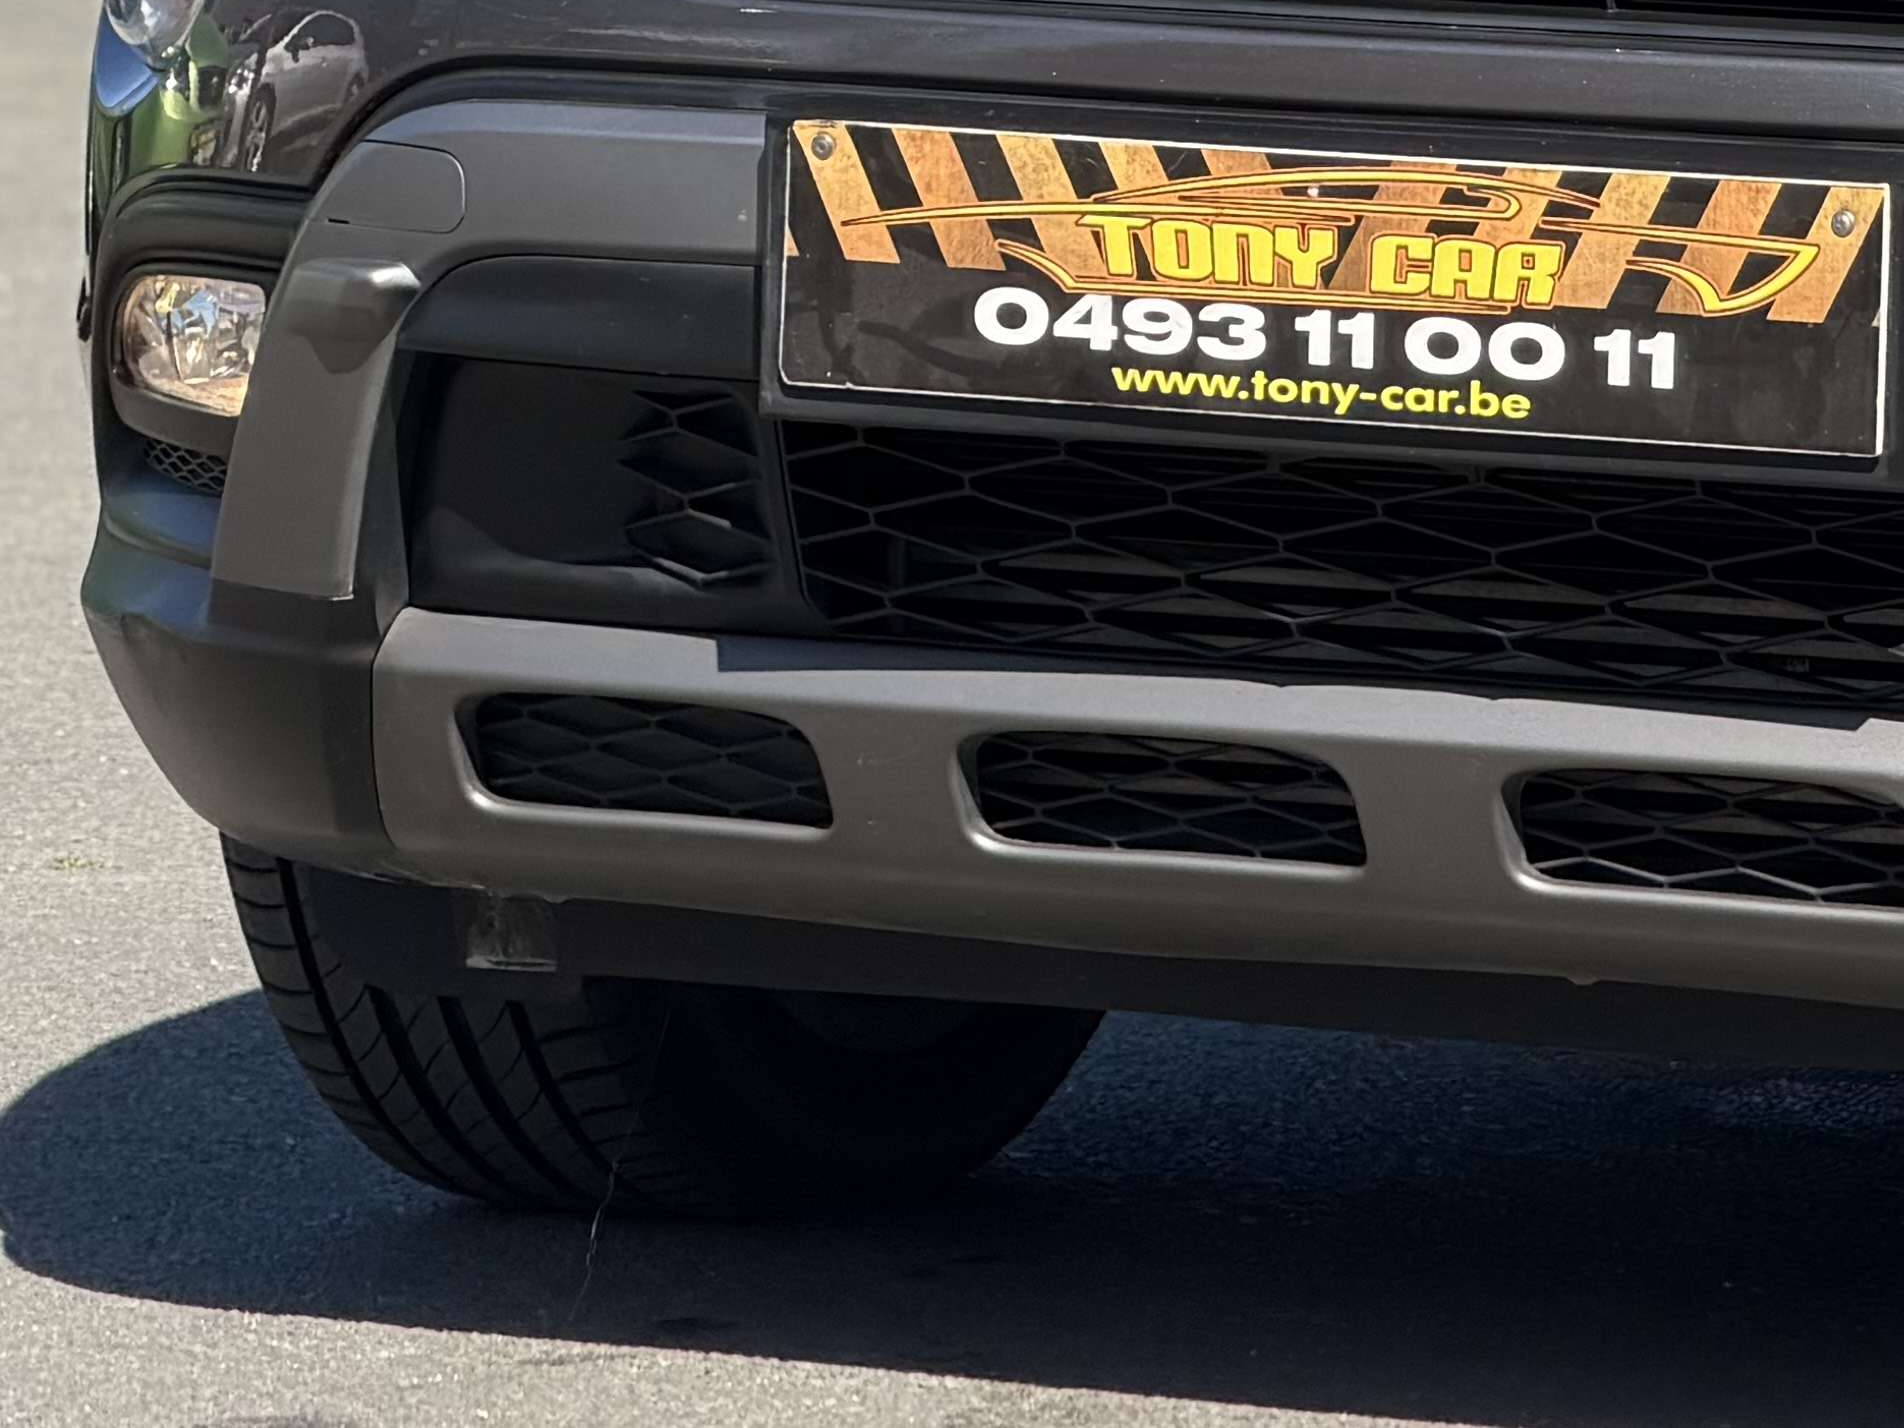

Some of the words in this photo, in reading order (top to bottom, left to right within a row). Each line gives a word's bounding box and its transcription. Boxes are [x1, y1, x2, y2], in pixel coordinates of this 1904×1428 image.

[1075, 213, 1337, 290] TONY
[1367, 233, 1565, 307] CAR
[973, 286, 1267, 361] 0493
[1294, 307, 1376, 370] 11
[1403, 315, 1566, 382] 00
[1593, 328, 1676, 390] 11
[1110, 366, 1532, 420] www.tony-car.be
